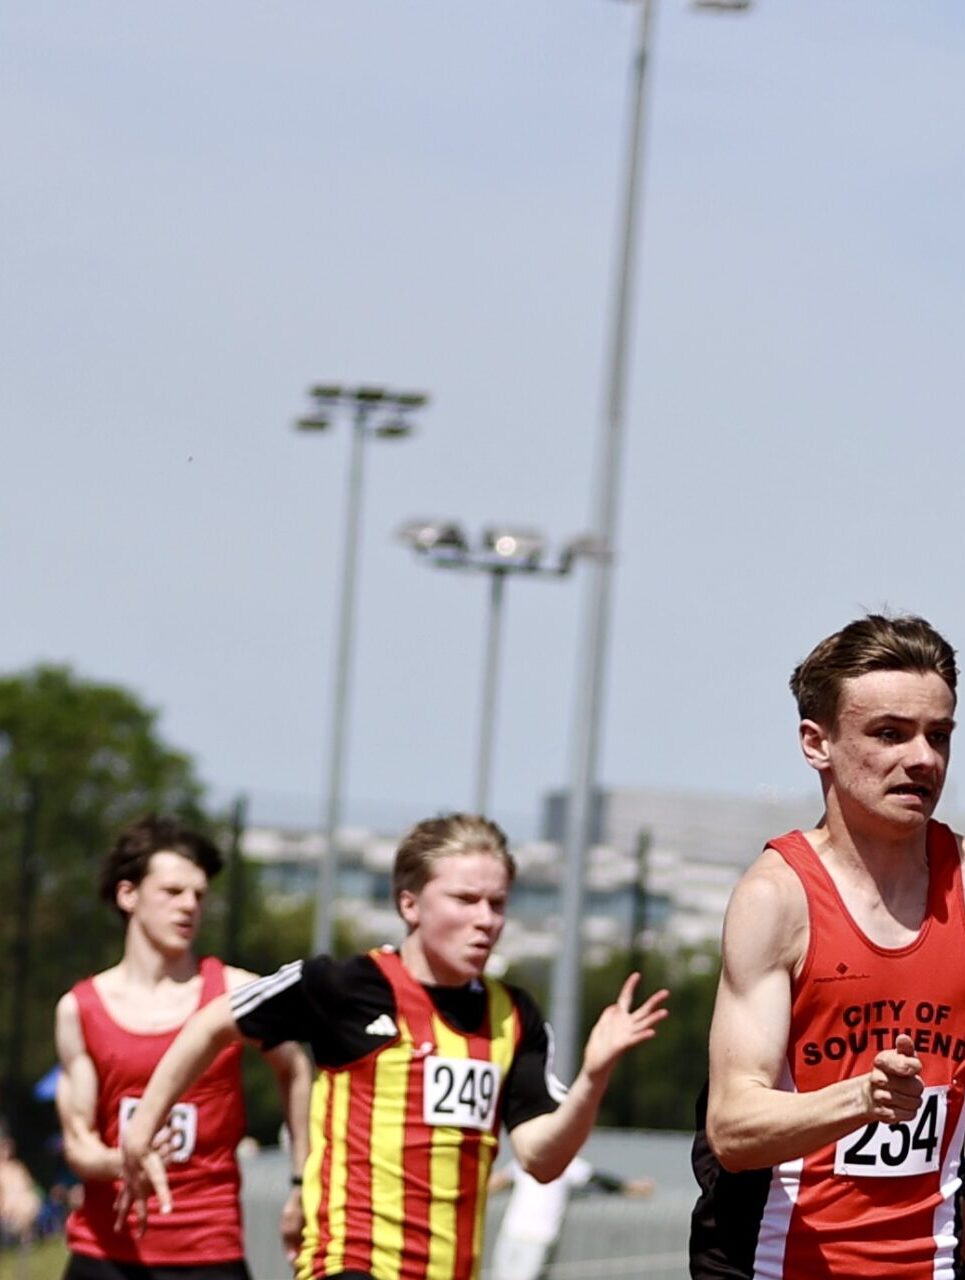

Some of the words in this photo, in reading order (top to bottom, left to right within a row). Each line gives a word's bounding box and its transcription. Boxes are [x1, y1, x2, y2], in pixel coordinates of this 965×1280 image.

[843, 1000, 906, 1027] CITY
[915, 1002, 952, 1025] OF
[433, 1065, 495, 1121] 249
